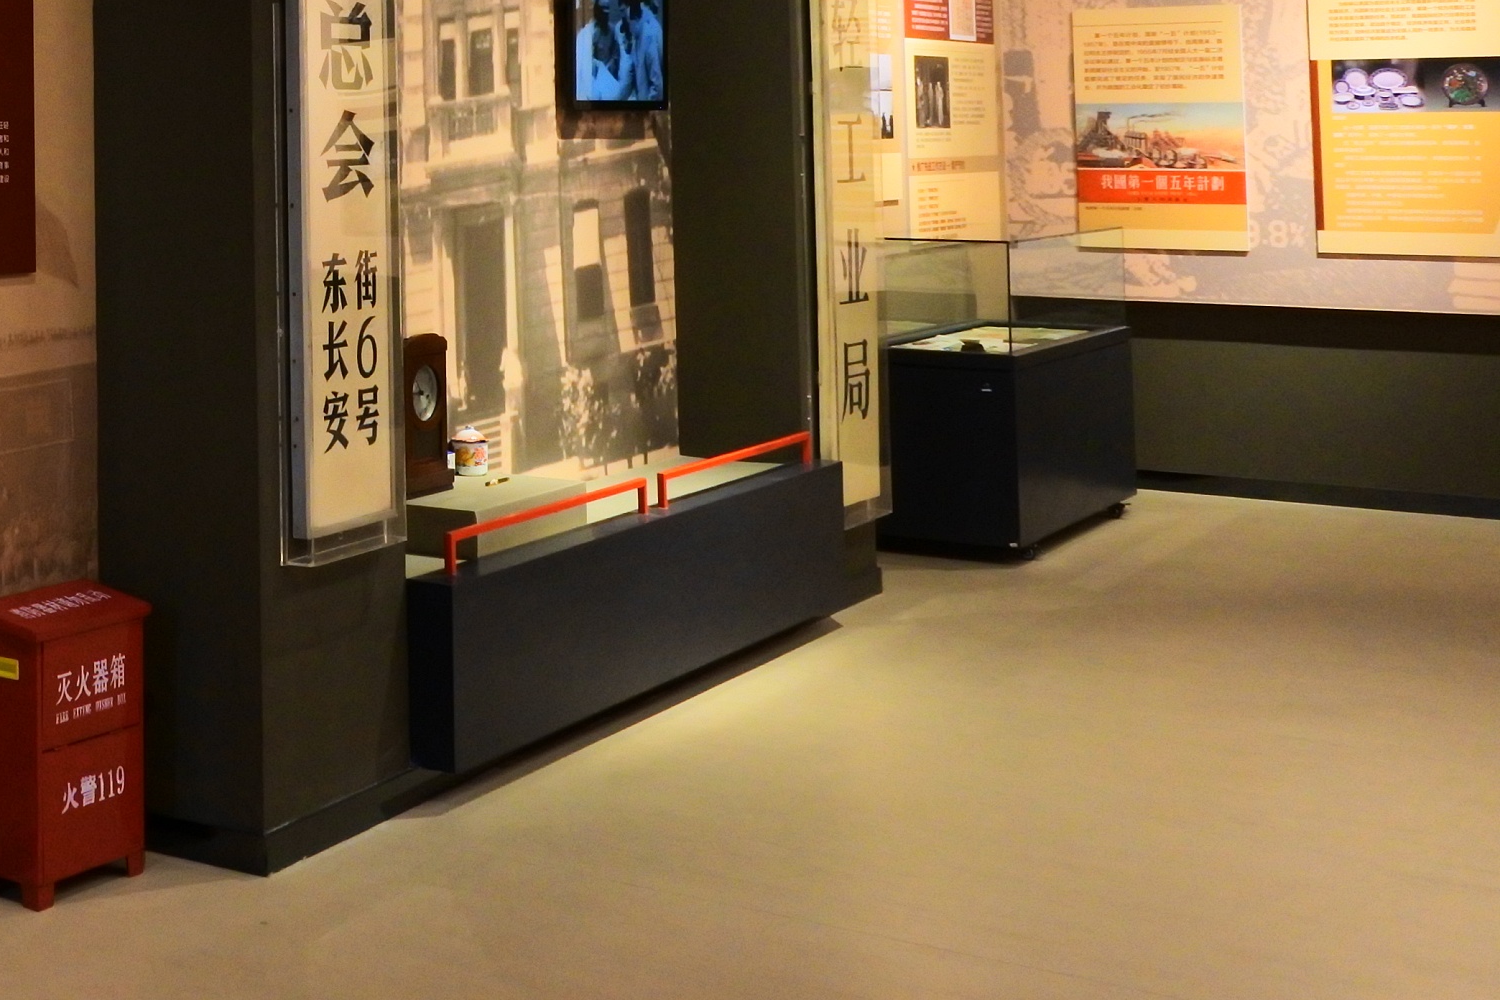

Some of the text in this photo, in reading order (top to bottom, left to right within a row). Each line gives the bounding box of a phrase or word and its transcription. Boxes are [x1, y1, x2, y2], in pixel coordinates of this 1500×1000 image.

[56, 653, 126, 705] 灭火器箱
[61, 765, 125, 814] 火警119
